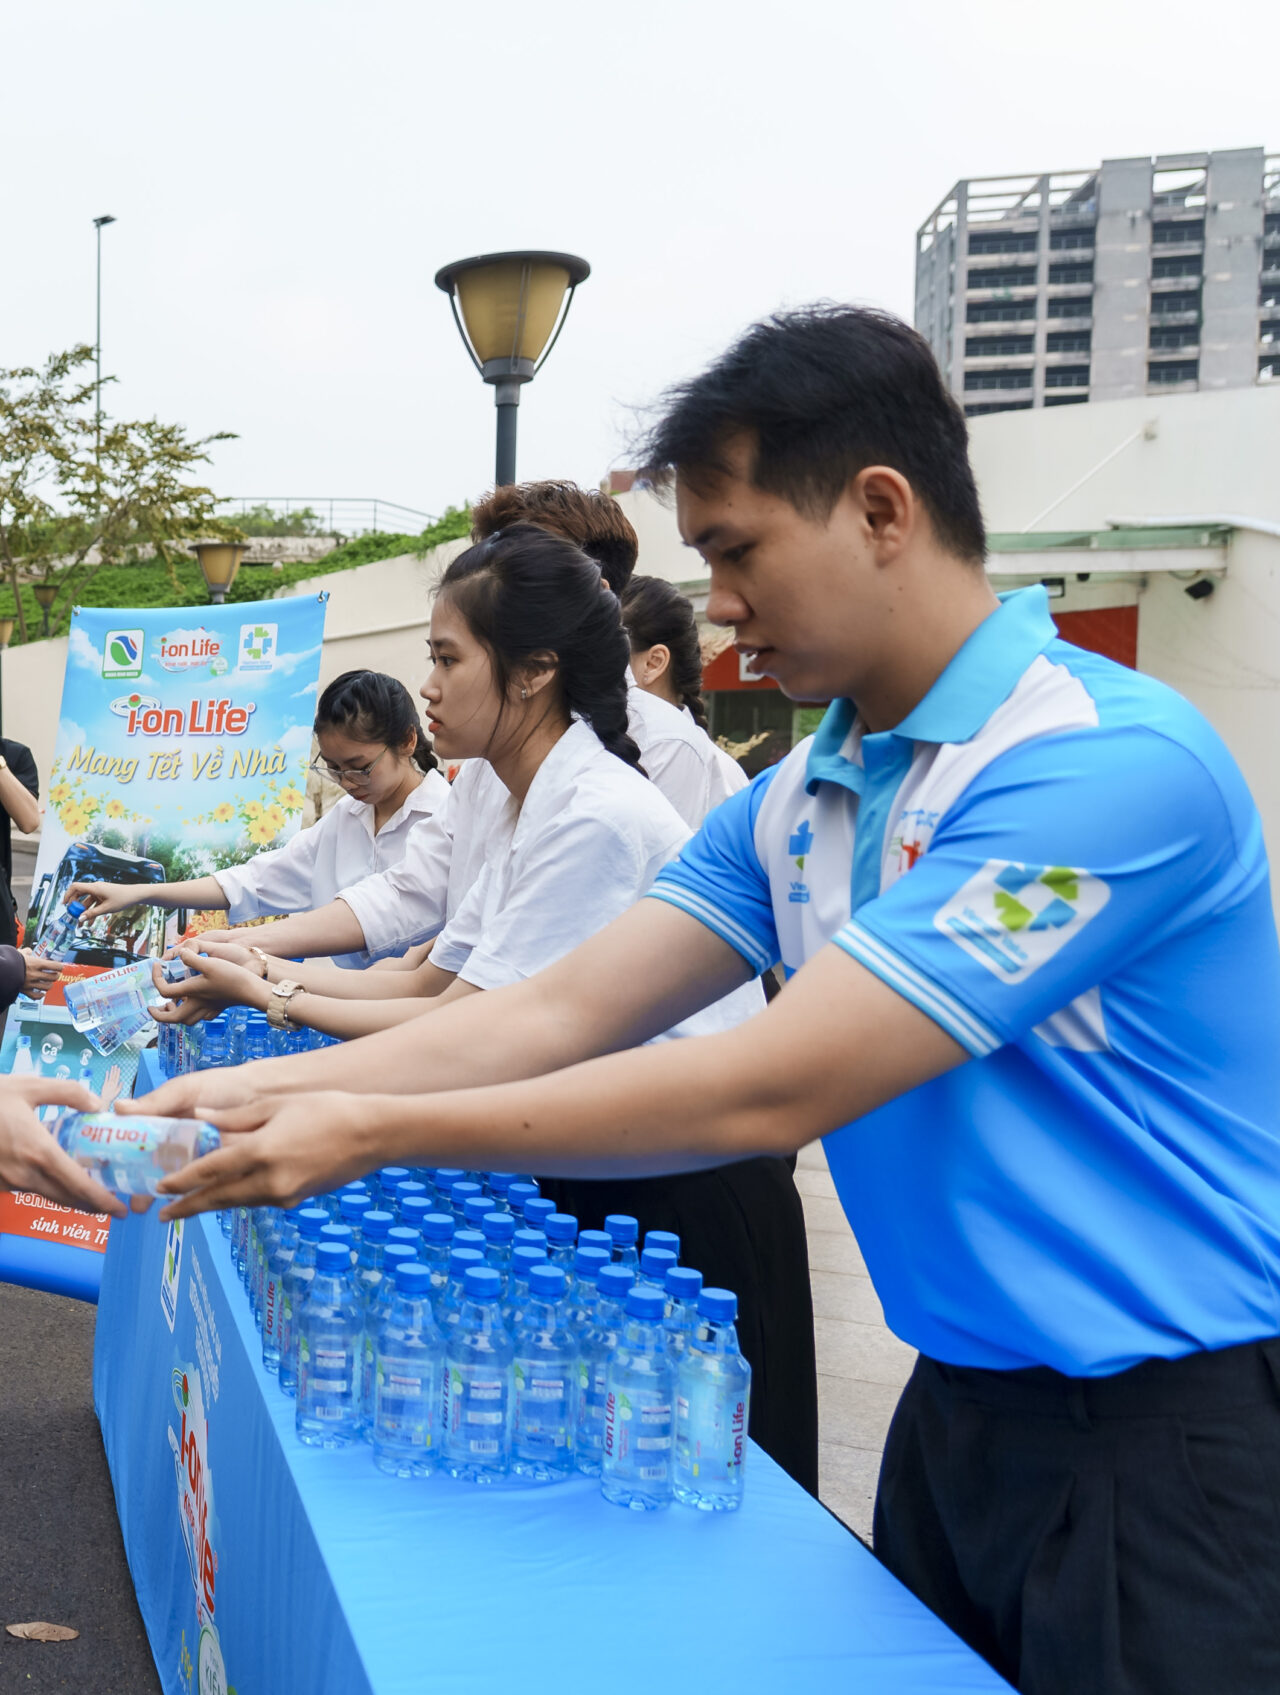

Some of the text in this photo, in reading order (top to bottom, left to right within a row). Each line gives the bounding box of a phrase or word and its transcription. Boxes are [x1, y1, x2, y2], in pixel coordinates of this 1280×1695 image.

[191, 639, 220, 656] Life
[188, 700, 247, 733] Life
[67, 745, 287, 783] Mang Tết Về Nhà
[30, 1217, 59, 1234] sinh
[62, 1223, 91, 1241] viên
